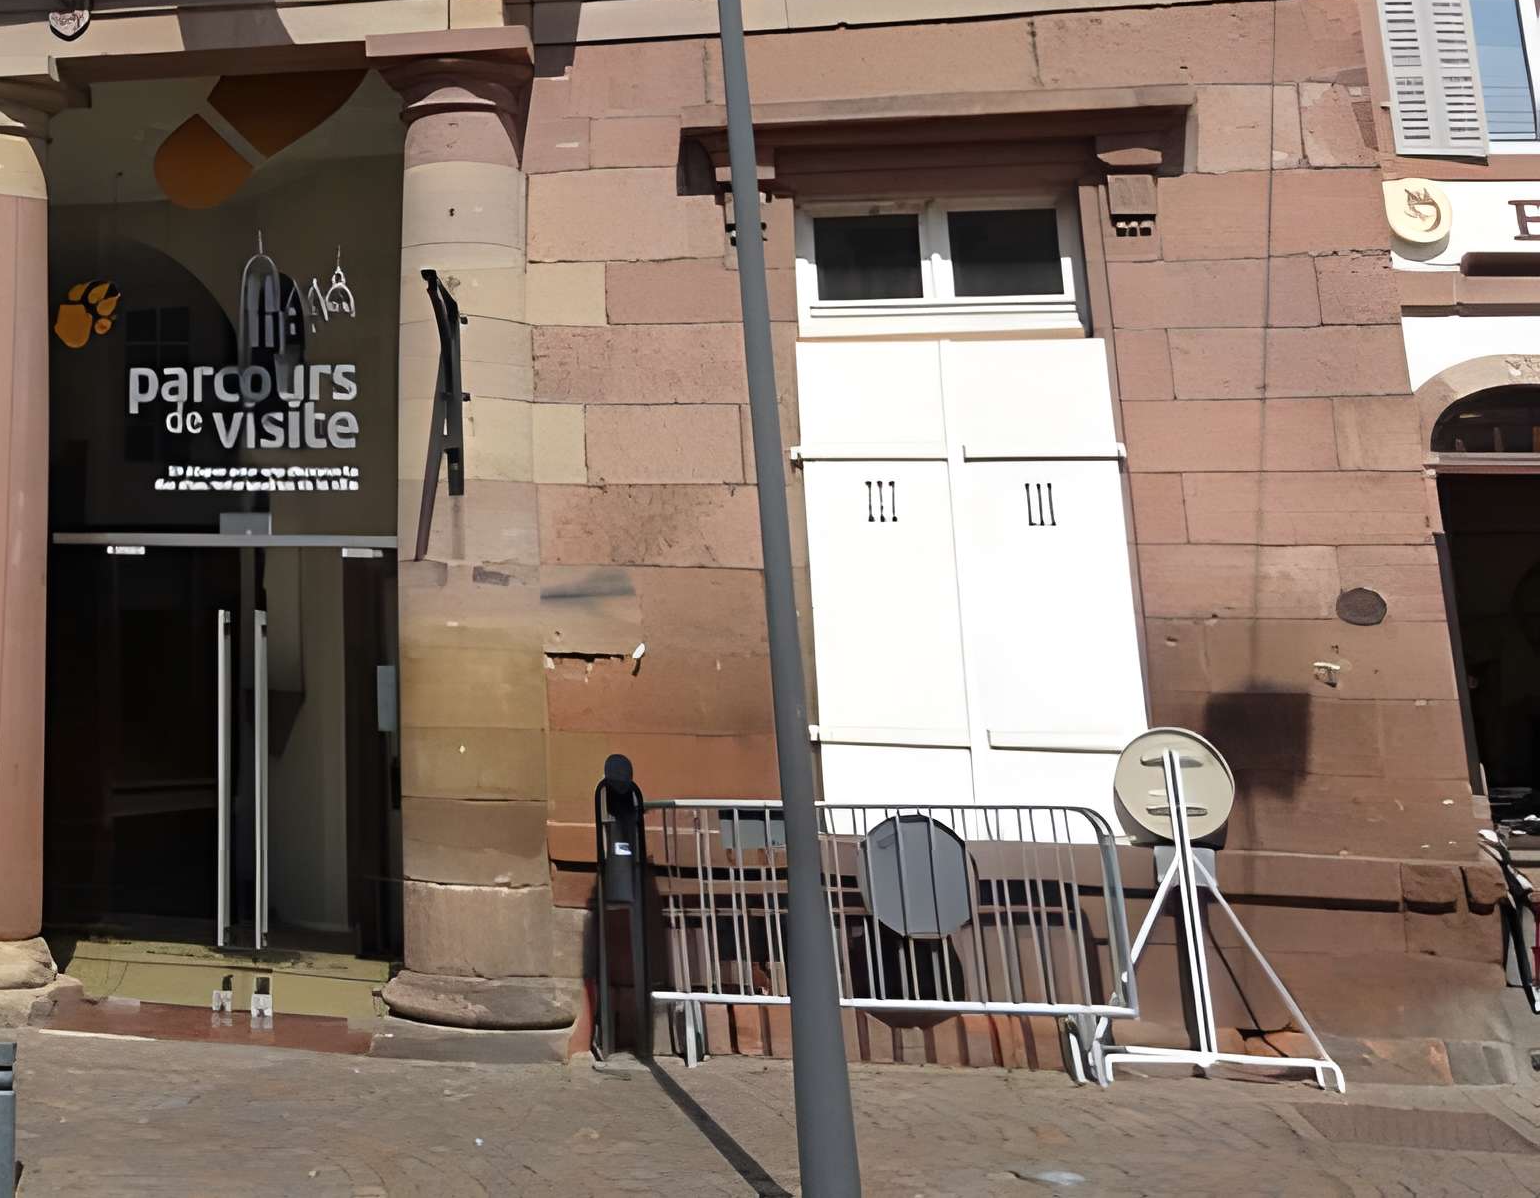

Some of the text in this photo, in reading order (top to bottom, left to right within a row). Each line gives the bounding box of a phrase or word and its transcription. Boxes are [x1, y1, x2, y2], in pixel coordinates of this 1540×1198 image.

[128, 363, 358, 415] parcours
[165, 398, 360, 449] de visite
